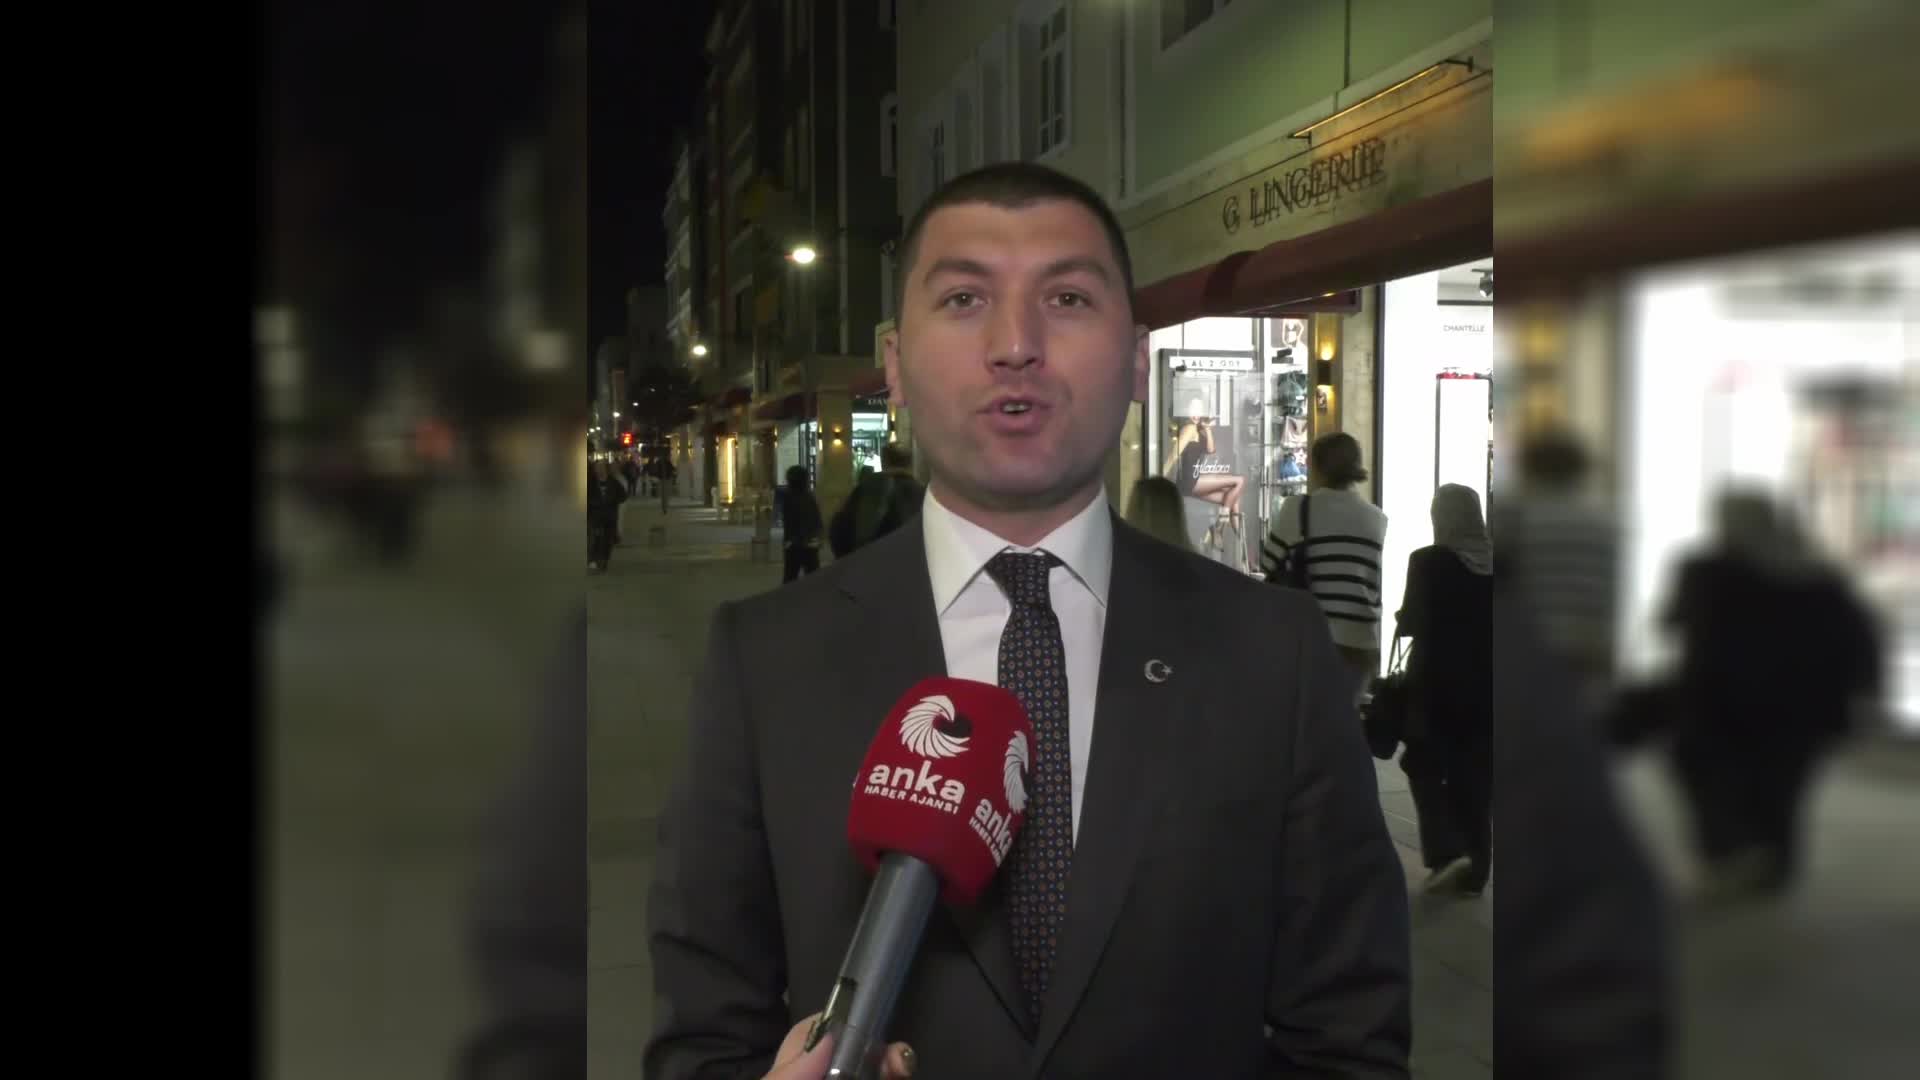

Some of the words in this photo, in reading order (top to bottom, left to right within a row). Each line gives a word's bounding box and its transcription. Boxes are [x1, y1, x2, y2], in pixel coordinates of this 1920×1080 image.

[1250, 137, 1387, 228] LINGERIE
[1443, 324, 1485, 333] CHANTELLE
[864, 785, 907, 801] HABER
[909, 793, 959, 815] AJANSI
[869, 760, 965, 804] anka
